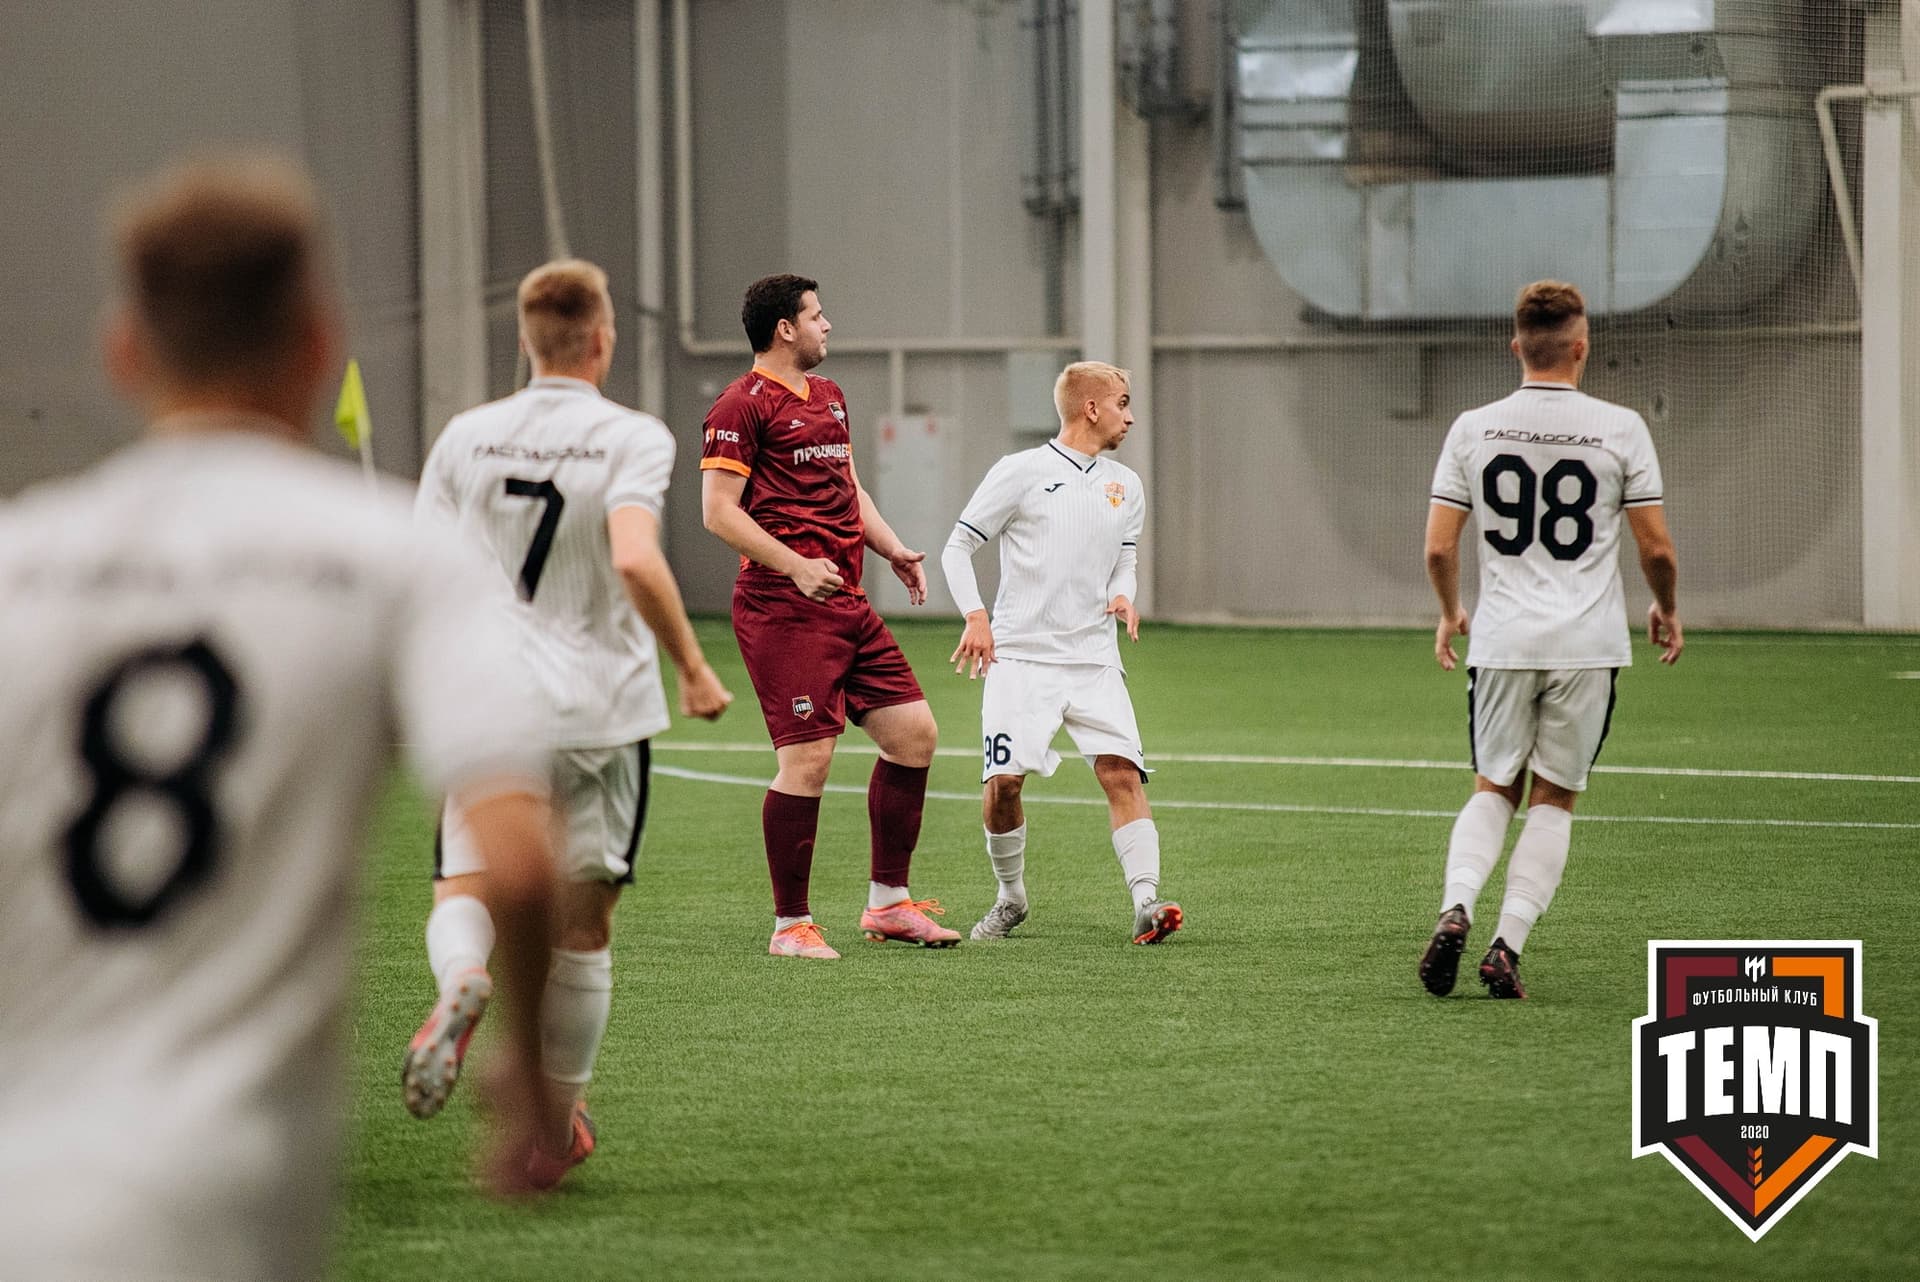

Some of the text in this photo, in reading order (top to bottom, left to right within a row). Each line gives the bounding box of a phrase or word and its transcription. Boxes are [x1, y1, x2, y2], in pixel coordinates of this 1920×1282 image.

[716, 430, 740, 443] ПСБ
[1484, 429, 1604, 449] РАСПАДСКАЯ
[505, 477, 565, 603] 7
[1482, 454, 1598, 561] 98
[61, 634, 242, 932] 8
[985, 733, 1012, 770] 96
